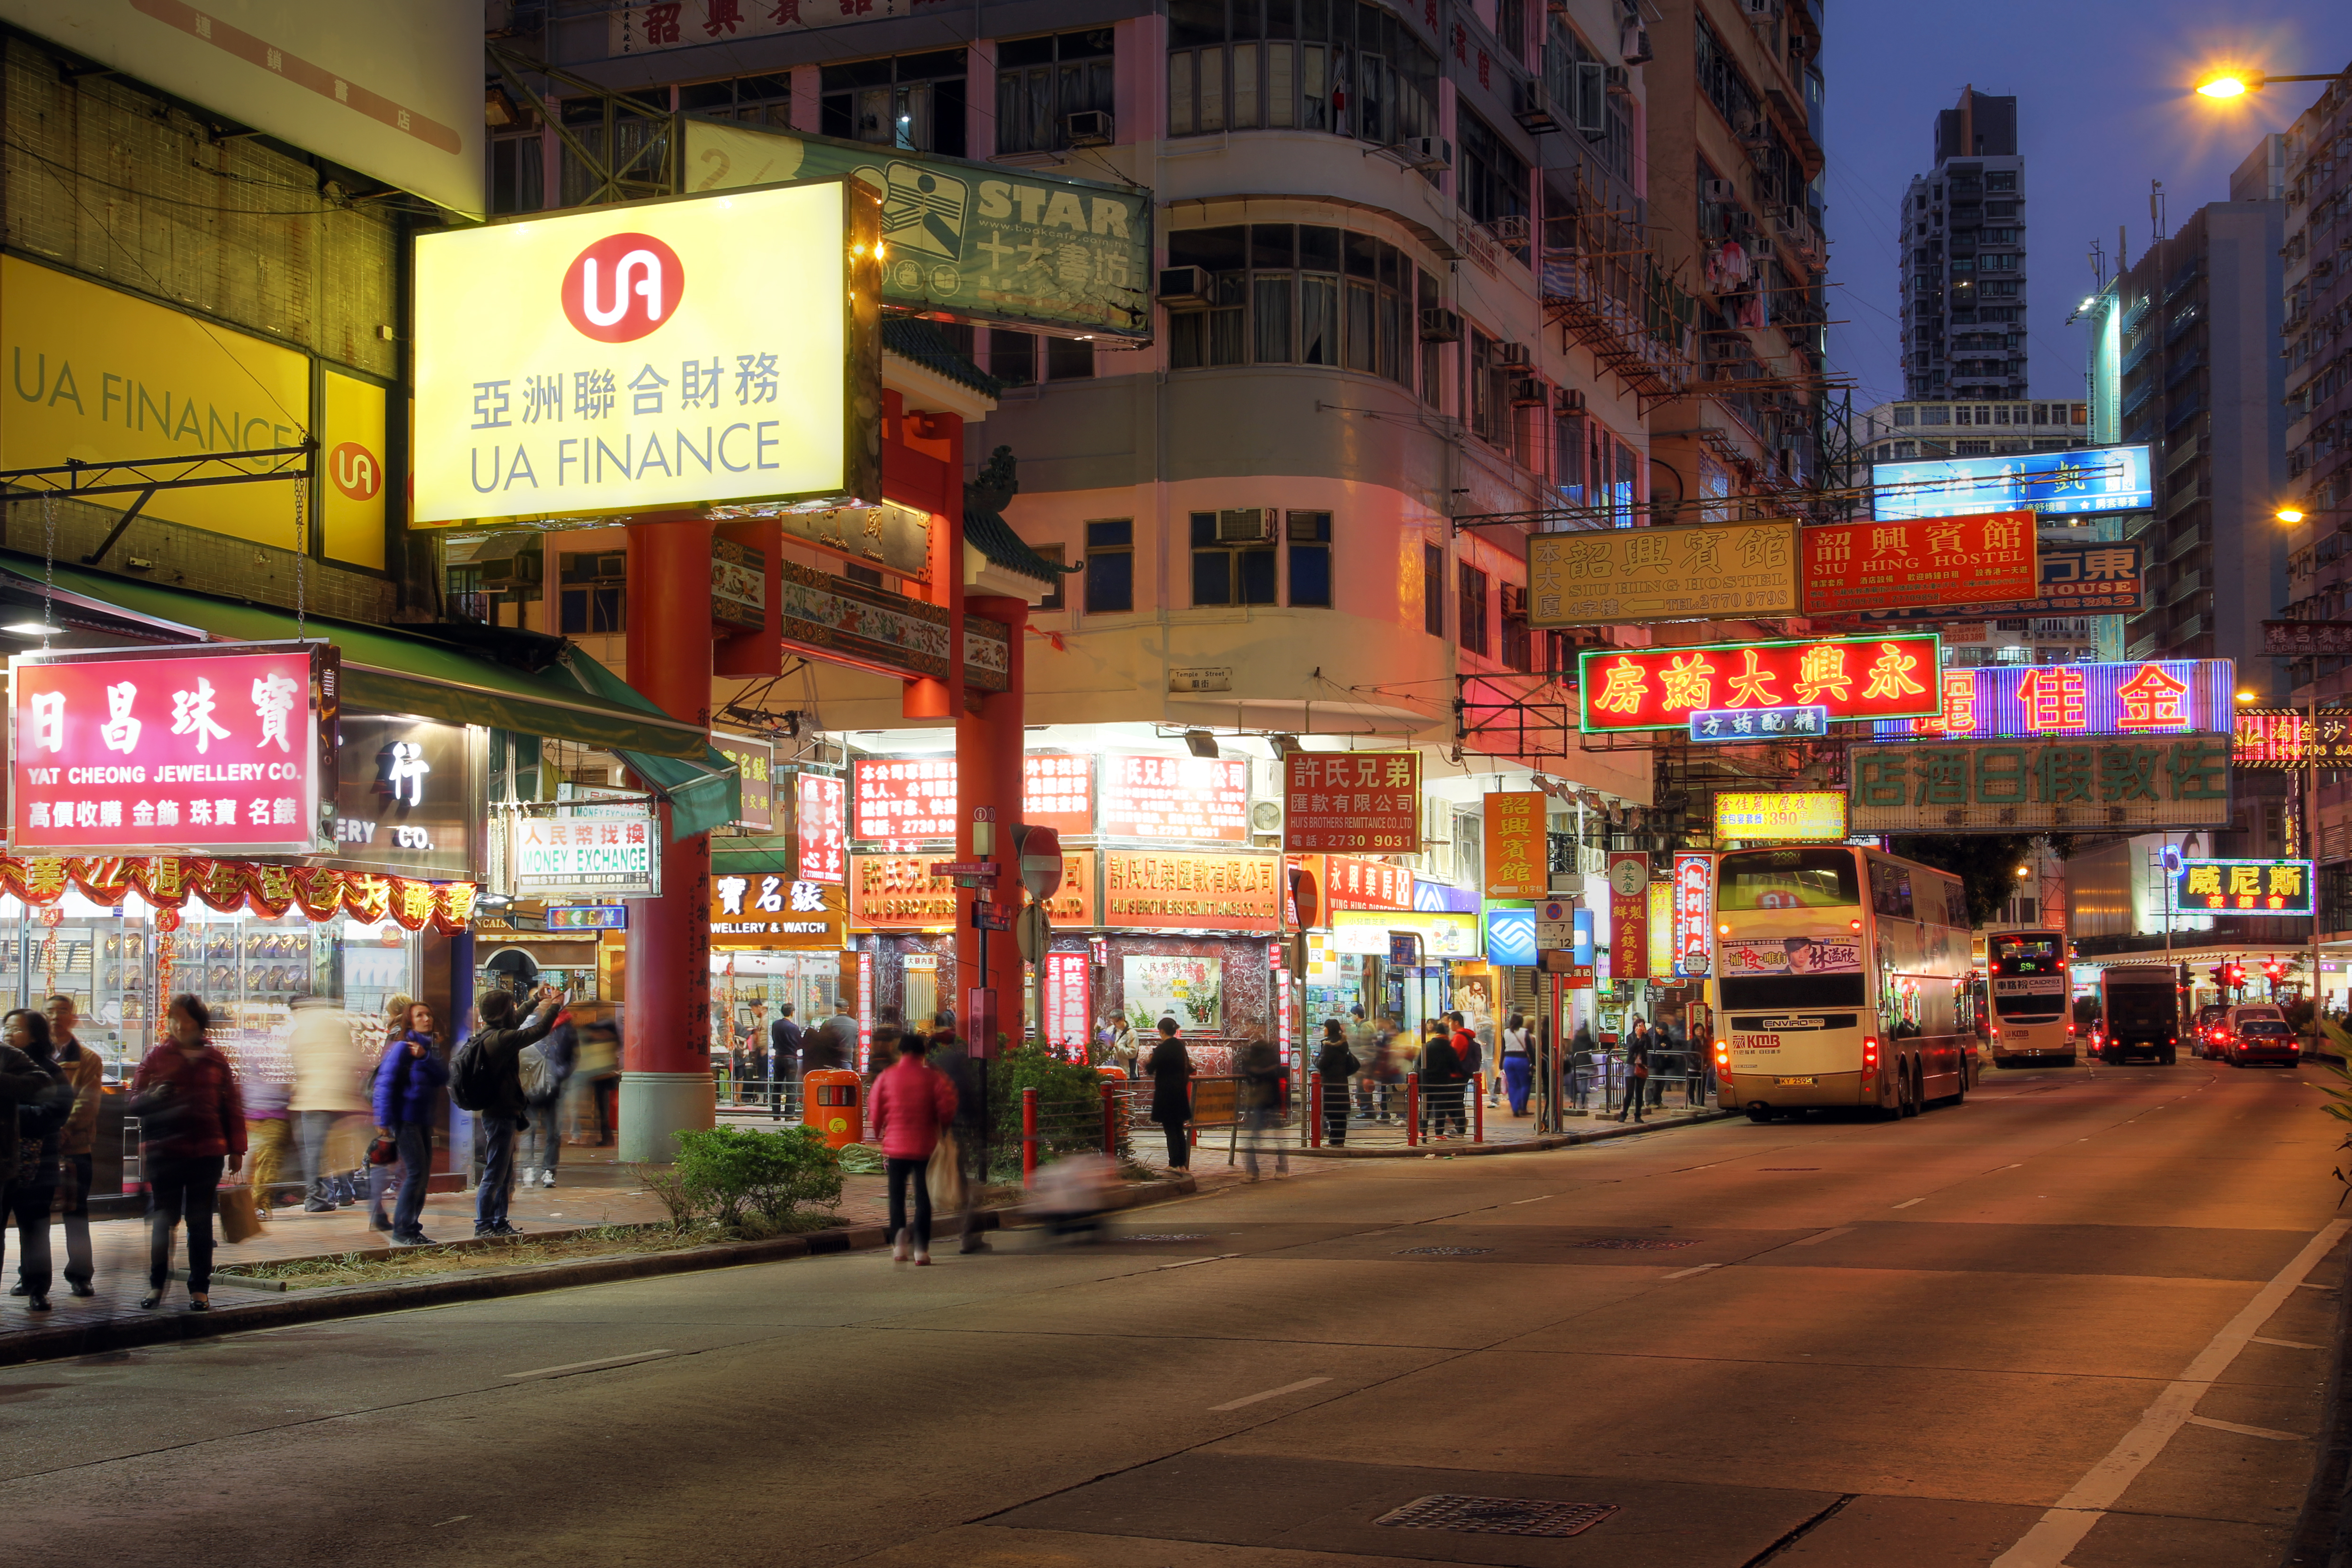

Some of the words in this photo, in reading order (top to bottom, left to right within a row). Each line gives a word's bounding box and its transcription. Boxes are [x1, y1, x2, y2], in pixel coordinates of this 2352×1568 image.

[977, 179, 1130, 240] STAR
[978, 219, 1130, 250] www.bookcafe.com.hk
[583, 249, 662, 327] UA
[471, 352, 781, 430] 亞洲聯合財務
[14, 346, 85, 416] UA
[102, 372, 293, 472] FINANCE
[472, 442, 539, 494] UA
[559, 420, 780, 487] FINANCE
[1814, 517, 2023, 562] 韶興賓館
[1813, 562, 1848, 575] SIU
[1862, 557, 1920, 572] HING
[1933, 550, 2025, 567] HOSTEL
[1568, 583, 1610, 597] SIU
[1615, 579, 1680, 595] HING
[1685, 573, 1788, 591] HOSTEL
[1746, 589, 1788, 607] 9798
[1837, 597, 1884, 607] 27709798
[1191, 680, 1209, 688] 廟街
[31, 673, 299, 755] 日昌珠寶
[2276, 745, 2327, 756] SANDS
[27, 767, 61, 785] YAT
[68, 765, 146, 784] CHEONG
[153, 763, 265, 783] JEWELLERY
[268, 762, 302, 780] CO.
[388, 740, 430, 807] 行
[1294, 757, 1411, 789] 許氏兄弟
[28, 800, 123, 829] 高價收購
[132, 799, 179, 828] 金飾
[189, 798, 237, 827] 珠寶
[1291, 793, 1413, 813] 匯款有限公司
[524, 823, 645, 846] 人民幣找換
[901, 819, 936, 834] 2730
[1291, 817, 1308, 829] HUI'S
[1309, 817, 1344, 829] BROTHERS
[1344, 817, 1386, 829] REMITTANCE
[398, 825, 435, 850] CO.
[1327, 834, 1366, 847] 2730
[1373, 834, 1411, 847] 9031
[1497, 796, 1533, 883] 韶興賓館
[523, 849, 569, 873] MONEY
[577, 847, 646, 872] EXCHANGE
[1677, 858, 1692, 872] CARY
[1693, 857, 1711, 872] HOTEL
[521, 875, 581, 885] WESTERN
[585, 874, 624, 883] UNION
[1330, 860, 1393, 900] 永興藥房
[1621, 862, 1635, 893] 海天堂
[2188, 865, 2302, 896] 威尼斯
[863, 898, 893, 915] HUI'S
[895, 899, 956, 914] BROTHERS
[1112, 898, 1136, 914] HUI'S
[1138, 899, 1184, 916] BROTHERS
[1185, 900, 1241, 917] REMITTANCE
[1330, 898, 1348, 909] WING
[1612, 905, 1645, 920] 鮮製
[2209, 896, 2284, 909] 夜總會
[770, 922, 780, 933] &
[783, 922, 826, 933] WATCH
[1559, 924, 1566, 933] 7
[1559, 938, 1571, 948] 12
[1049, 982, 1060, 1039] REMITTANCE
[1747, 1034, 1781, 1049] KMB
